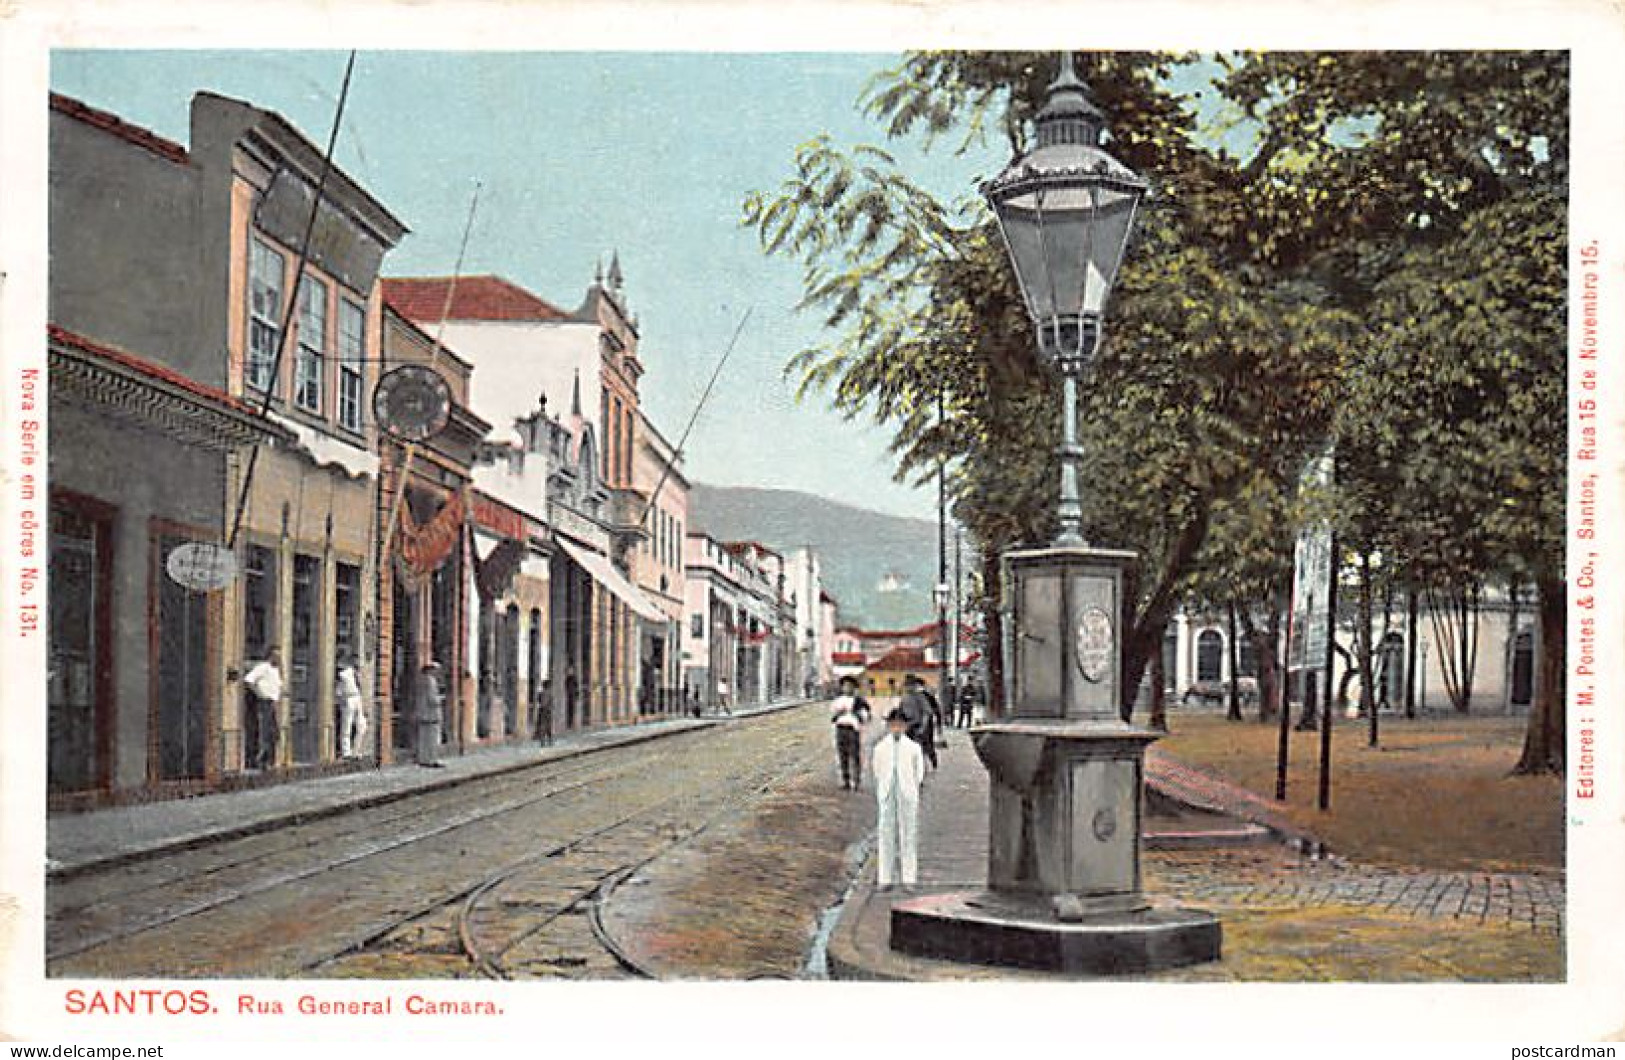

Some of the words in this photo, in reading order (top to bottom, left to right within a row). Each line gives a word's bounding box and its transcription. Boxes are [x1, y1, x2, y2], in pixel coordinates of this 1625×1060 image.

[1580, 240, 1598, 267] 15.
[1579, 272, 1598, 361] Novembro
[22, 368, 40, 411] Nova
[1580, 369, 1596, 391] de
[1579, 399, 1596, 420] 15
[22, 420, 40, 466] Serie
[1578, 426, 1596, 461] Rua
[21, 474, 35, 500] em
[1577, 473, 1599, 540] Santos,
[21, 510, 39, 558] côres
[20, 567, 39, 596] No.
[1577, 552, 1599, 590] Co.,
[20, 603, 38, 637] 131.
[1576, 595, 1595, 611] &
[1576, 619, 1595, 677] Pontes
[1576, 685, 1594, 706] M.
[64, 988, 219, 1015] SANTOS.
[237, 994, 284, 1015] Rua
[297, 994, 391, 1015] General
[405, 994, 503, 1015] Camara.
